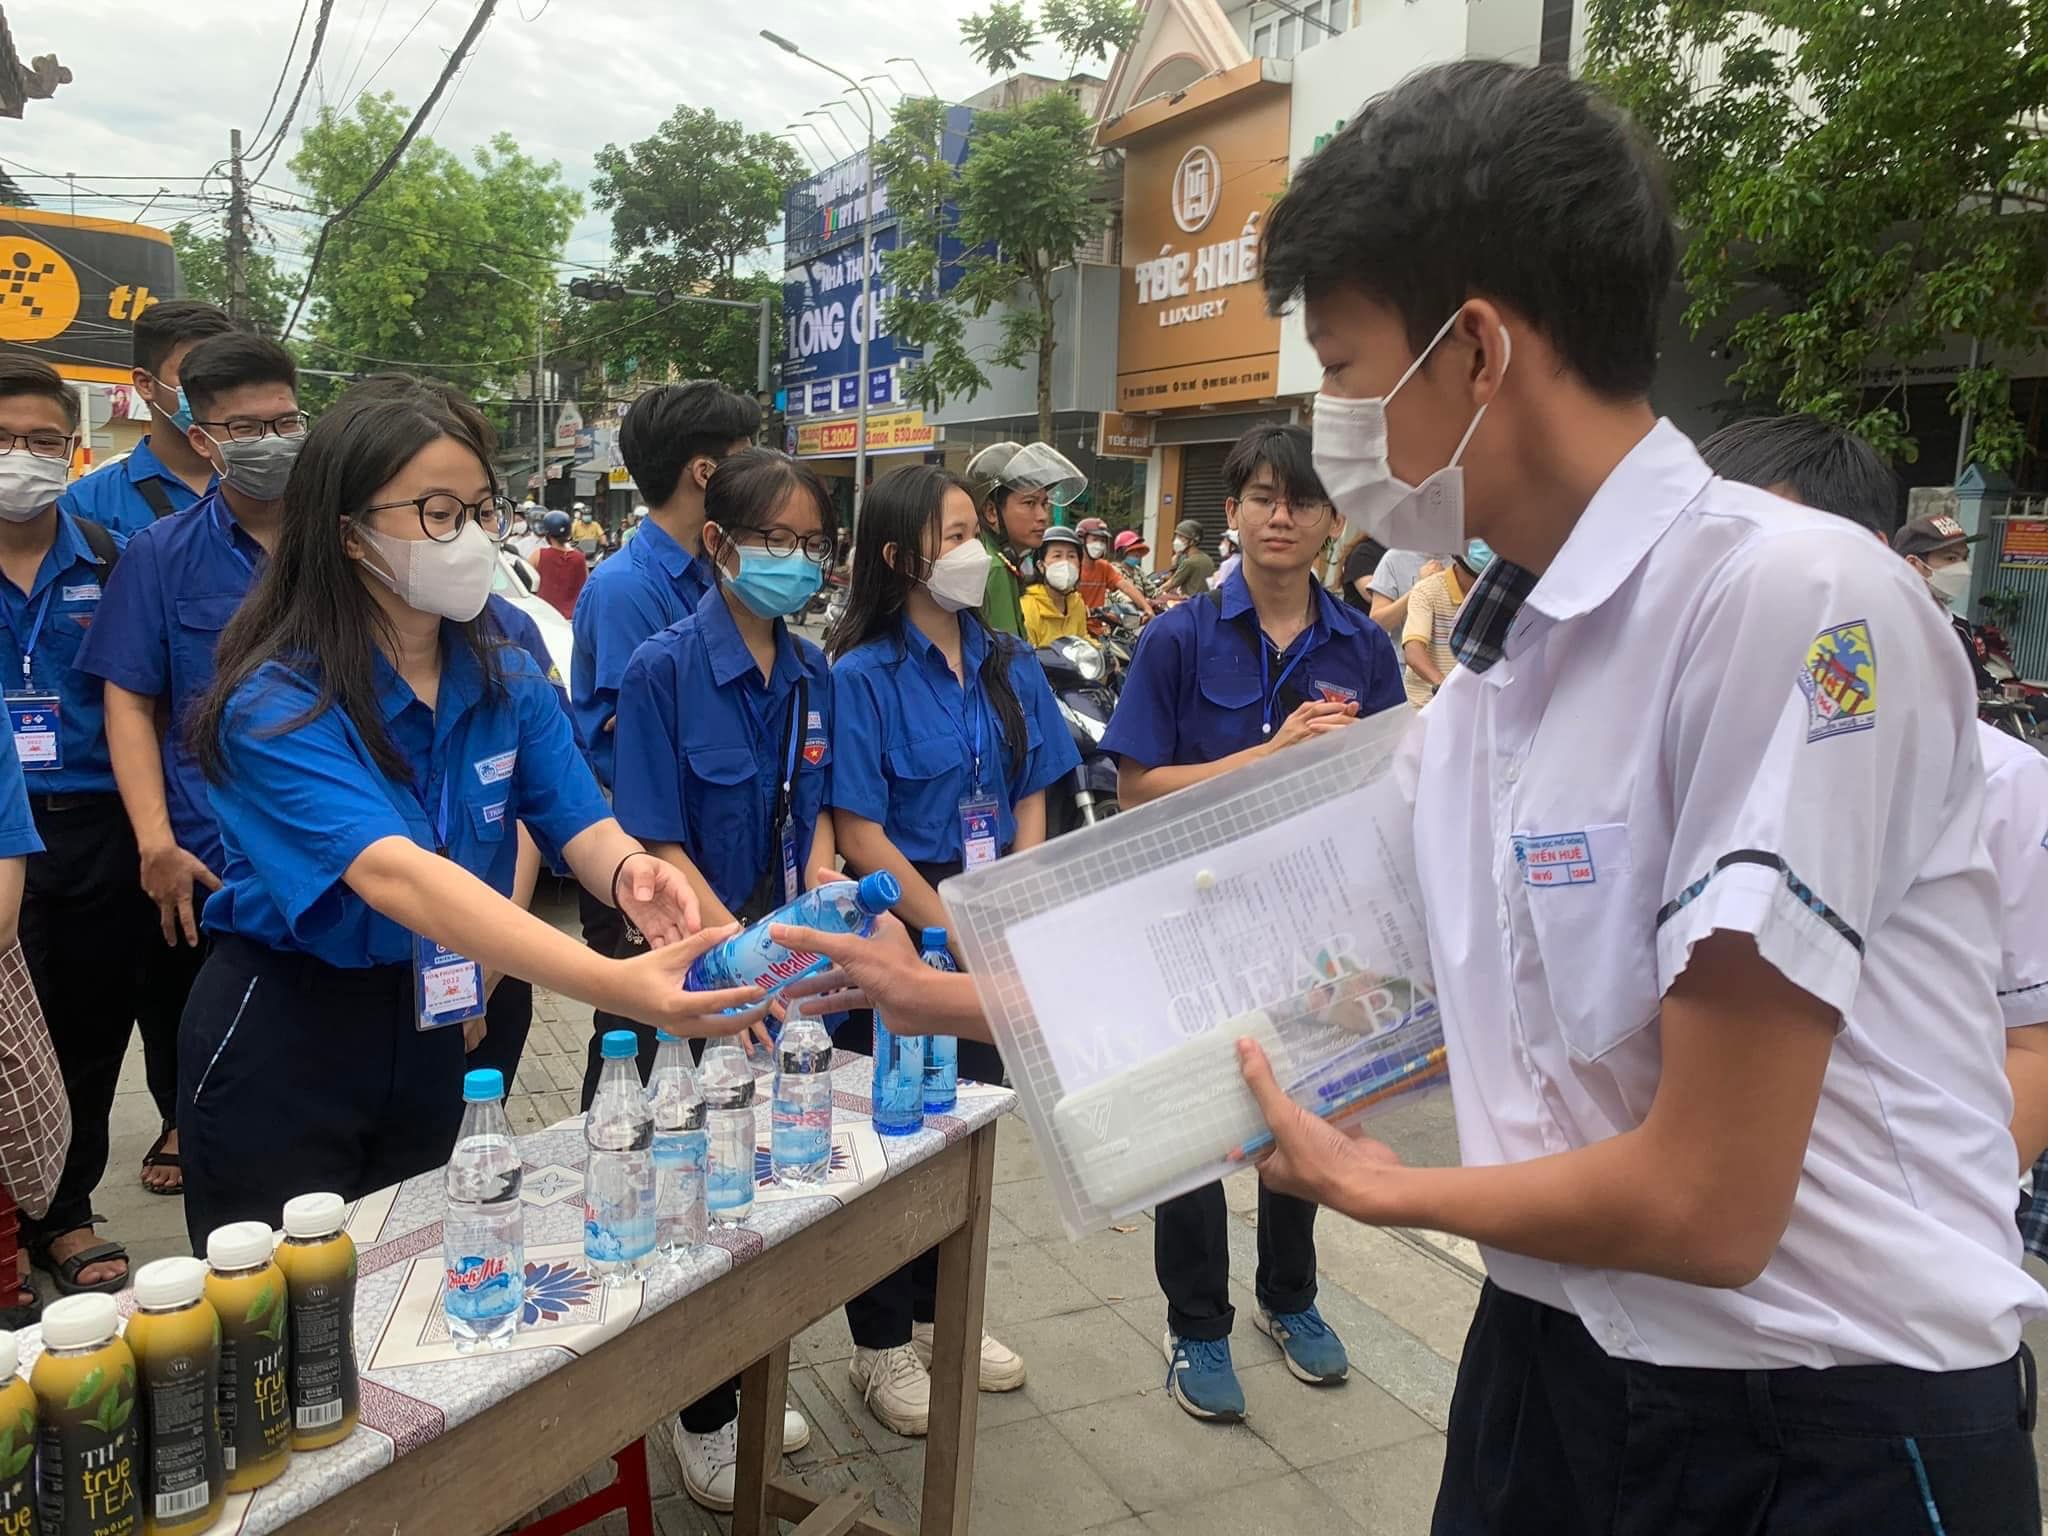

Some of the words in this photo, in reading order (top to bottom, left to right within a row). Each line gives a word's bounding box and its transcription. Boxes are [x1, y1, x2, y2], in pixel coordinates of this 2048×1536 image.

[789, 302, 846, 360] LONG
[1159, 299, 1226, 328] LUXURY
[80, 1443, 114, 1469] TH
[82, 1457, 131, 1494] true
[83, 1479, 135, 1520] TEA
